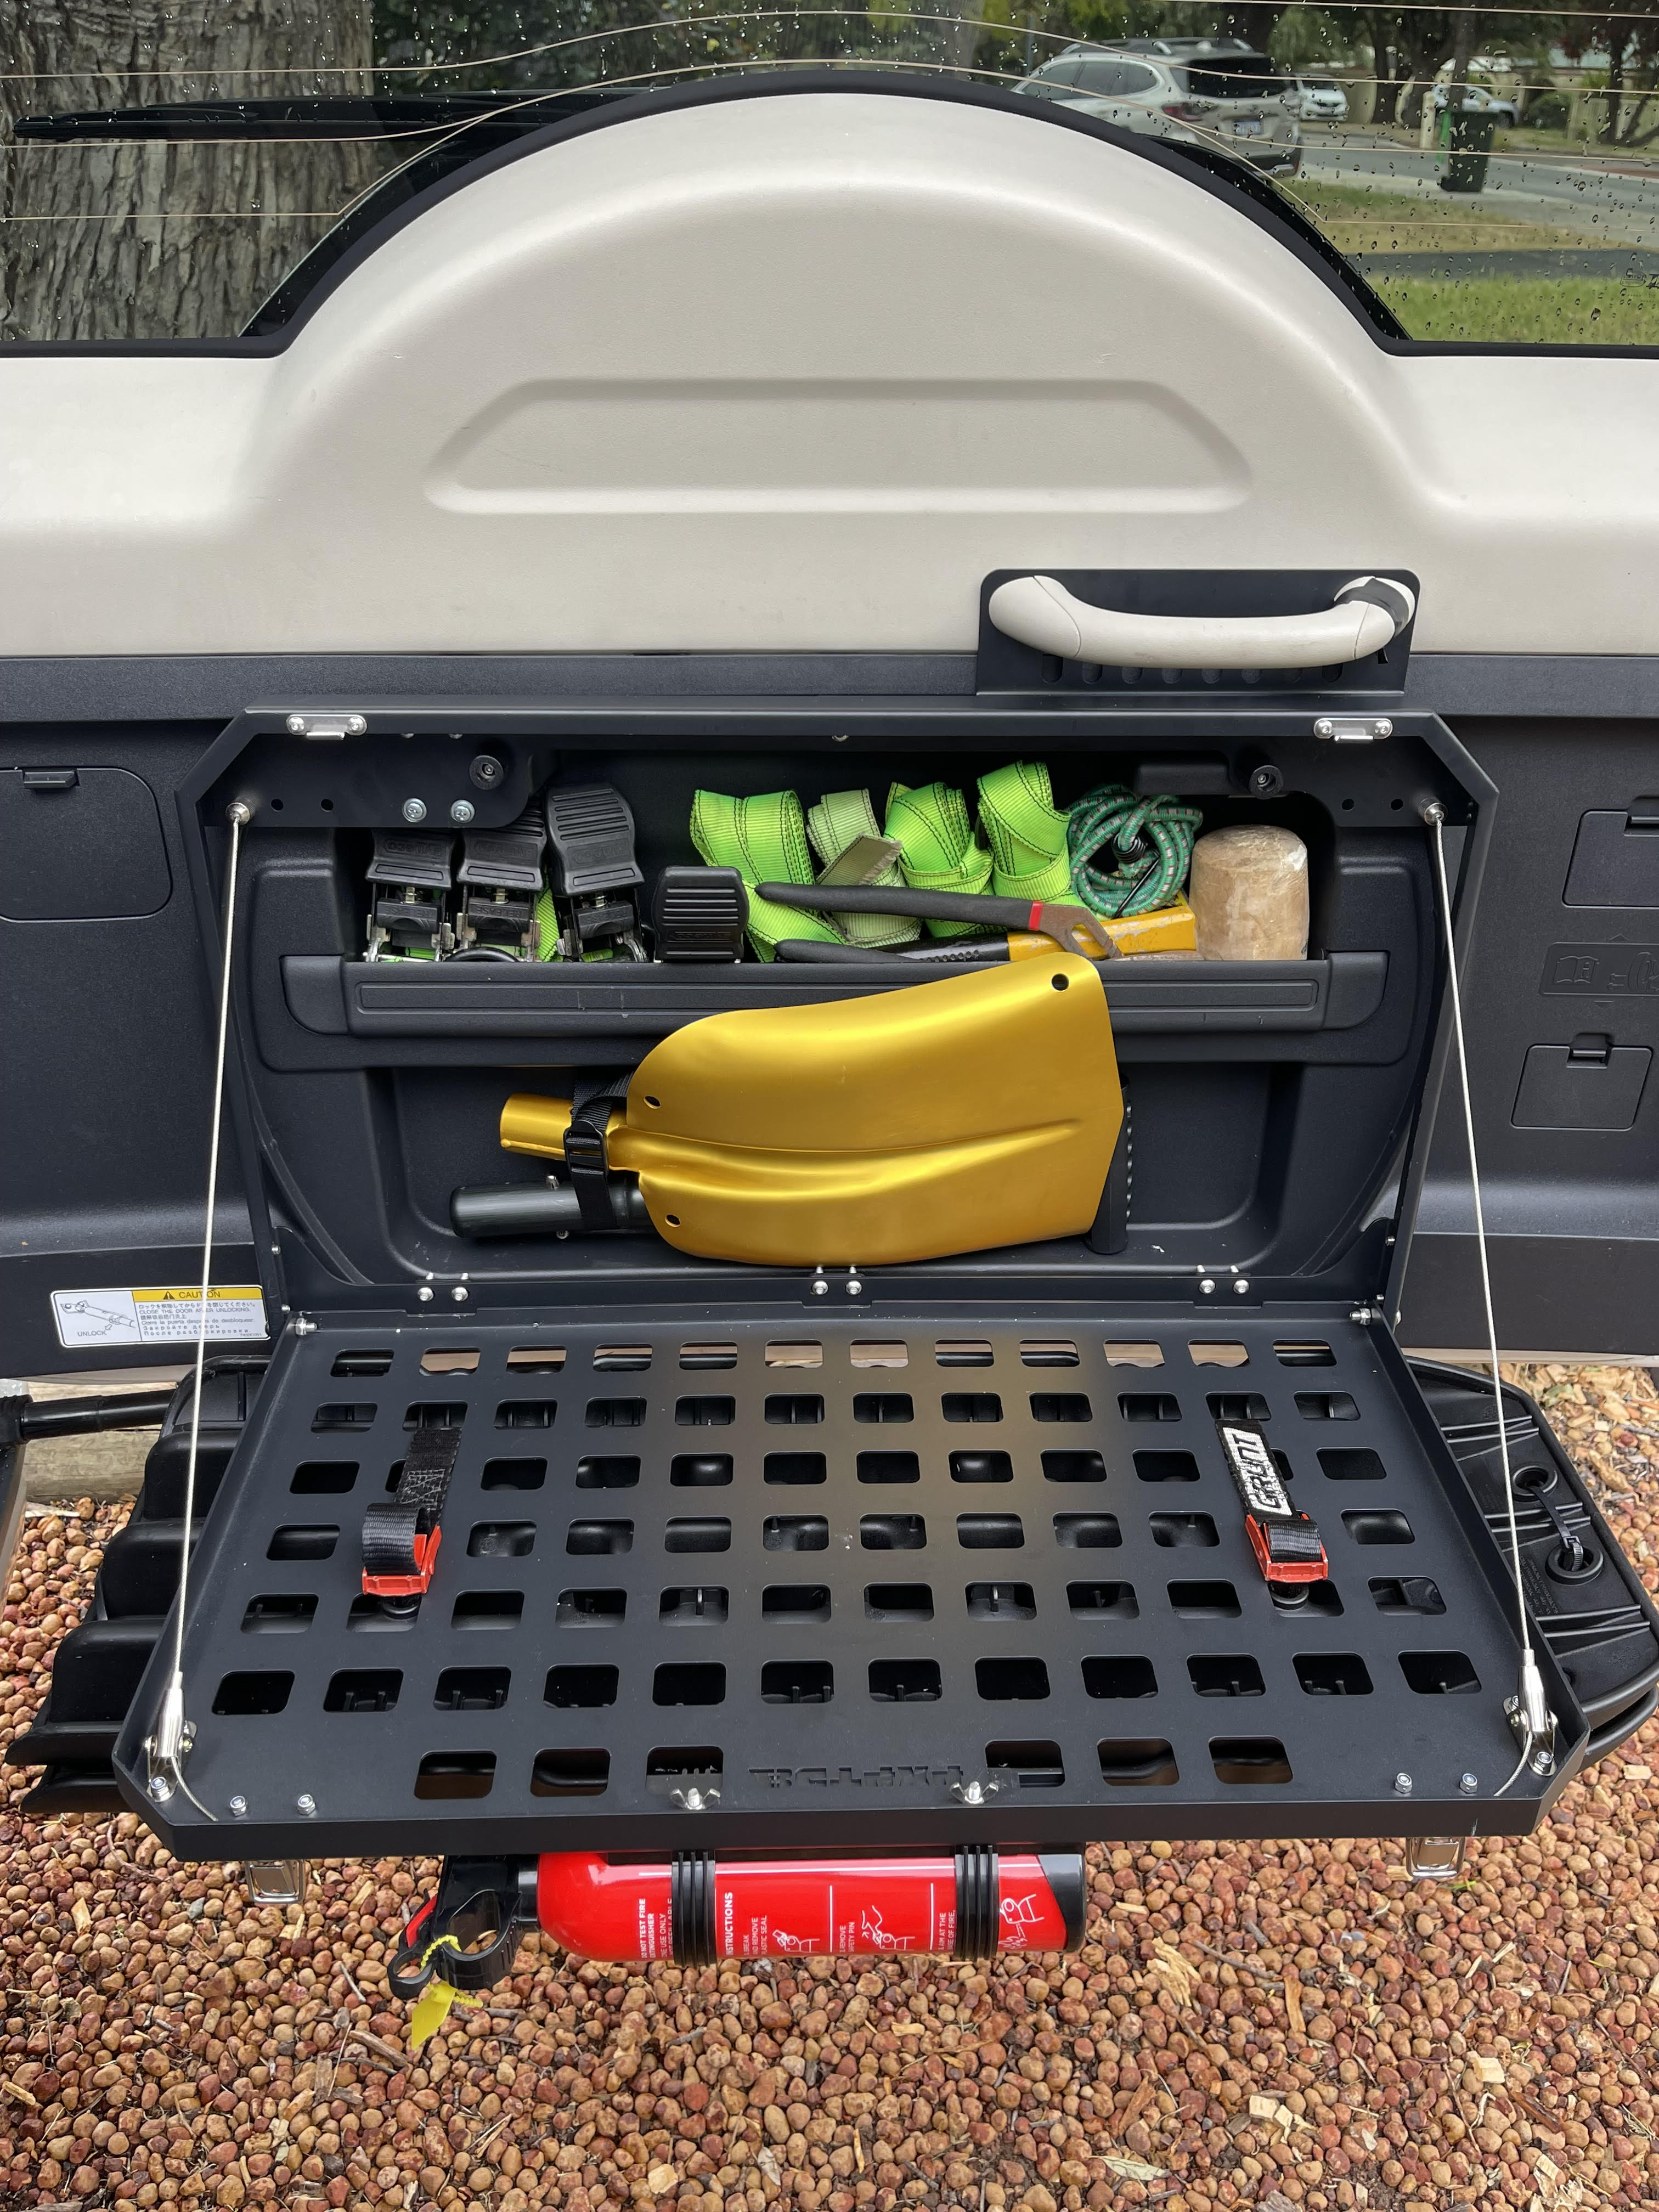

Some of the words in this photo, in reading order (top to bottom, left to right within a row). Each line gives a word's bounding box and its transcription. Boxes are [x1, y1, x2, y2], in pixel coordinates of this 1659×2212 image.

[477, 906, 521, 918] RELEASE
[725, 1892, 733, 1955] INSTRUCTIONS
[647, 1914, 656, 1958] EXTINGUISHER
[939, 1928, 945, 1937] AT
[947, 1929, 954, 1938] OF
